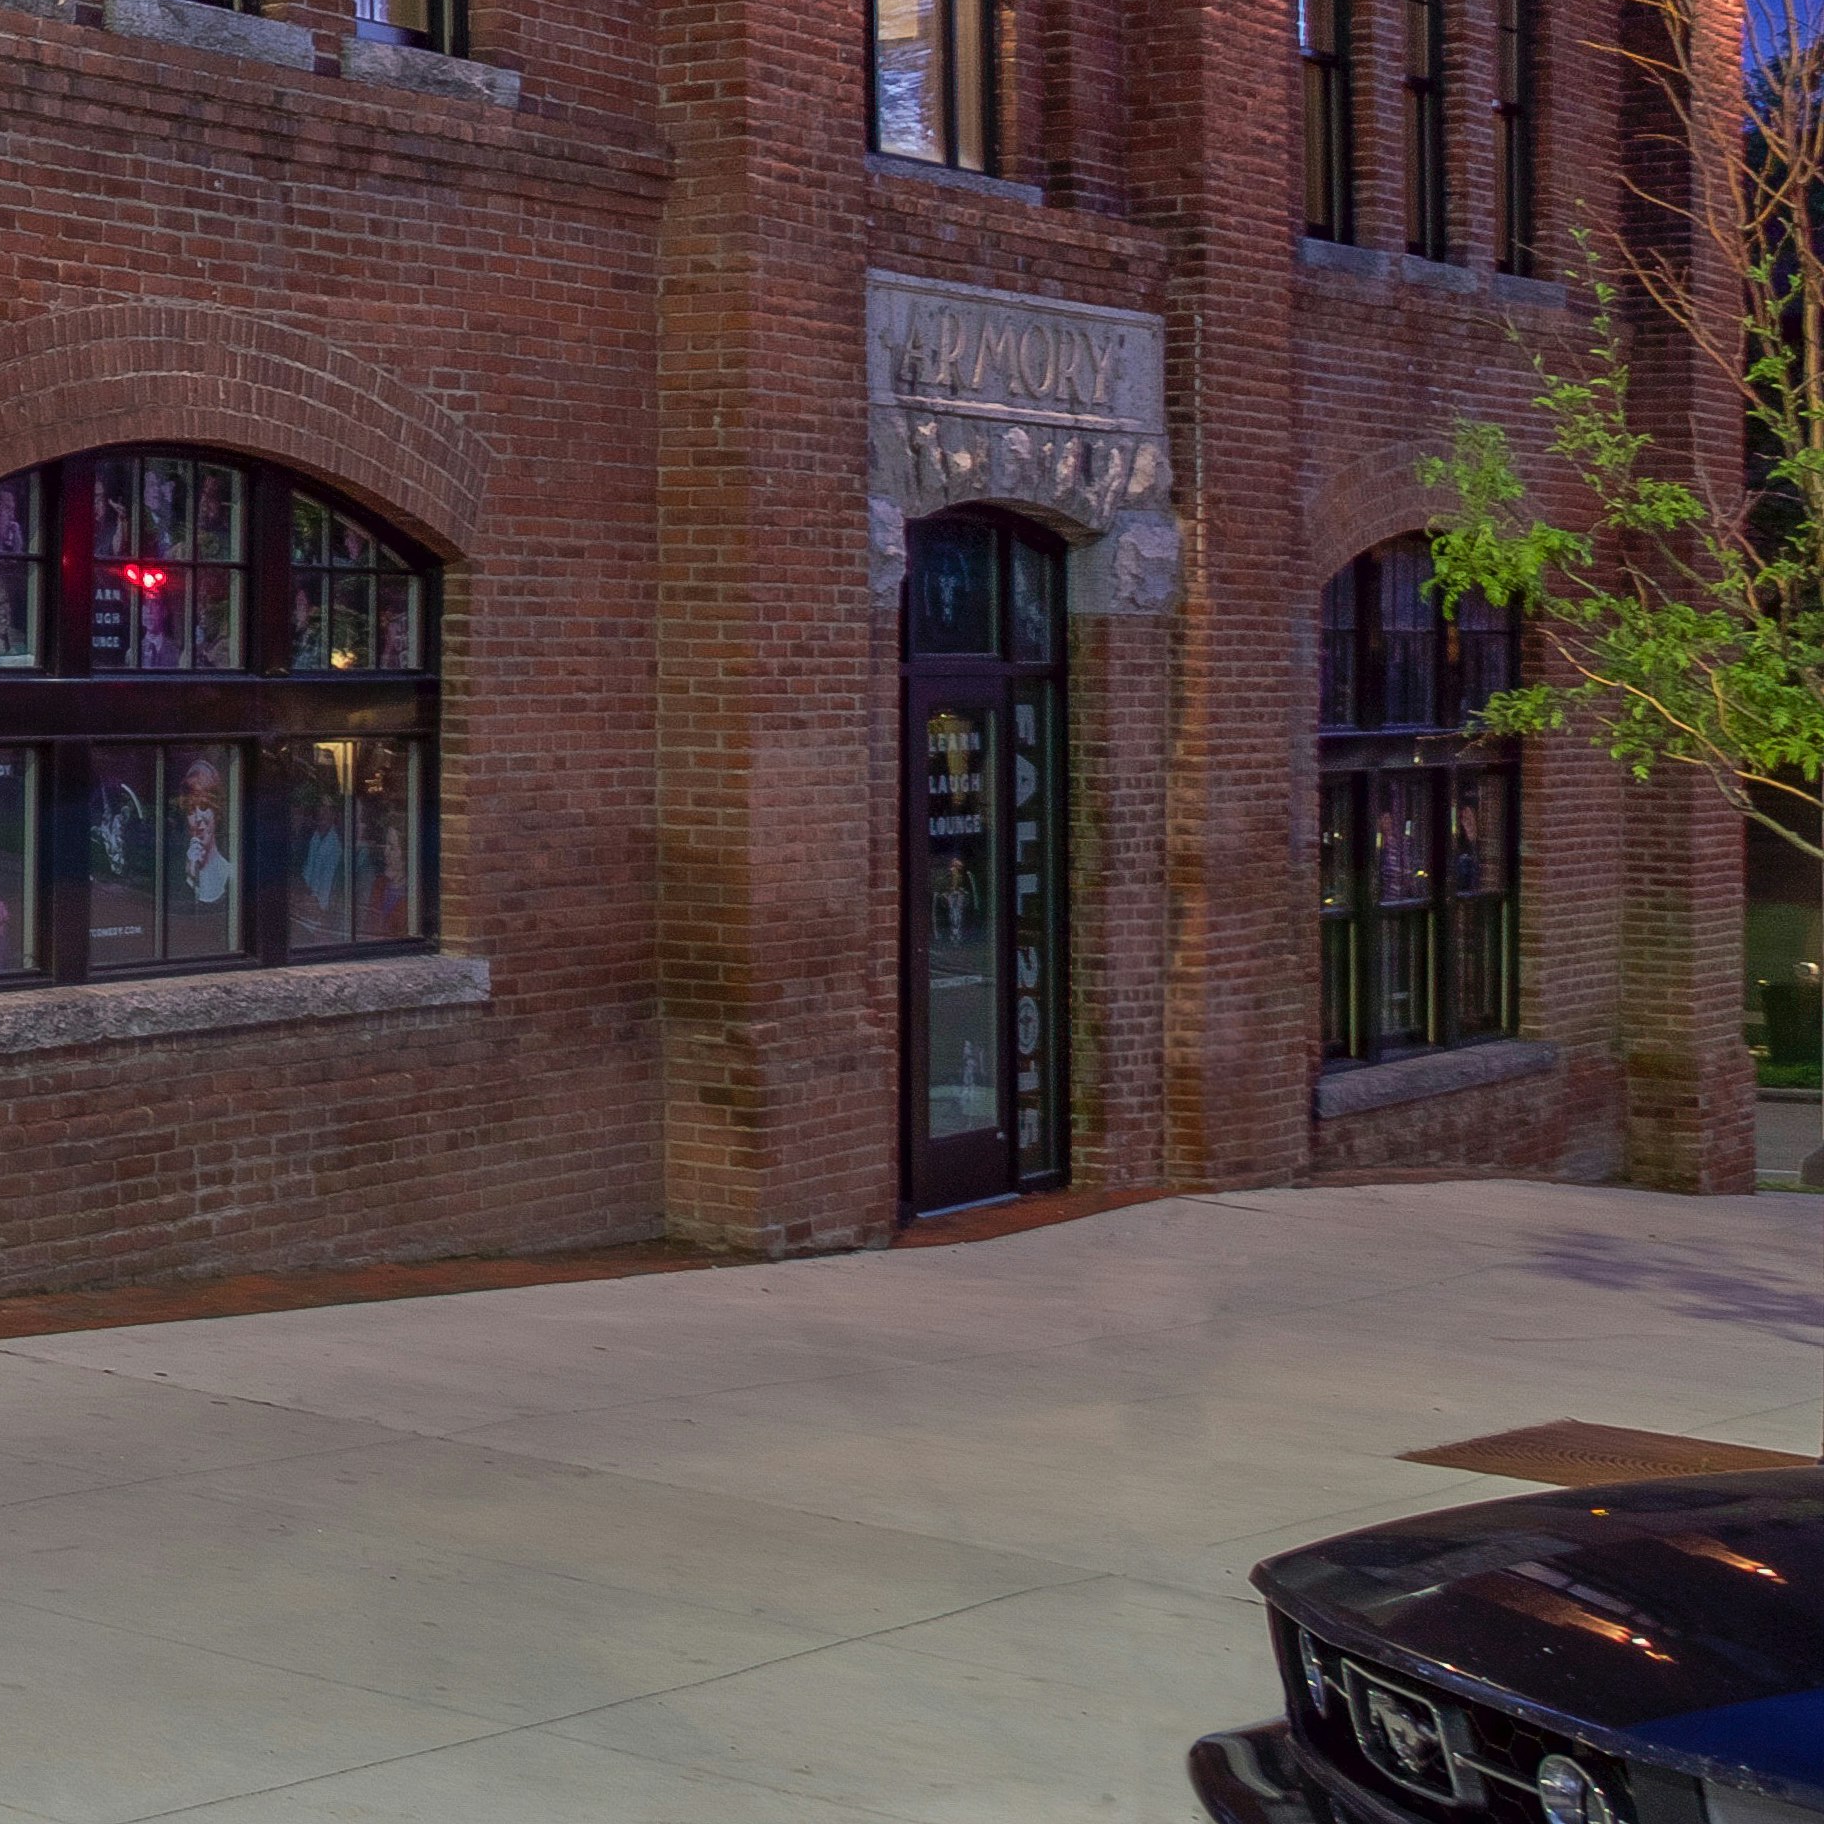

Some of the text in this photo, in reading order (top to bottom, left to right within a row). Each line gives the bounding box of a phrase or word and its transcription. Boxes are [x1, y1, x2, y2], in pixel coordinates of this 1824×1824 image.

[900, 304, 1116, 405] ARMORY
[95, 588, 121, 601] ARN
[95, 612, 121, 625] UGH
[92, 636, 120, 648] UNGE
[929, 773, 981, 794] LAUGH
[1015, 704, 1039, 916] FALL
